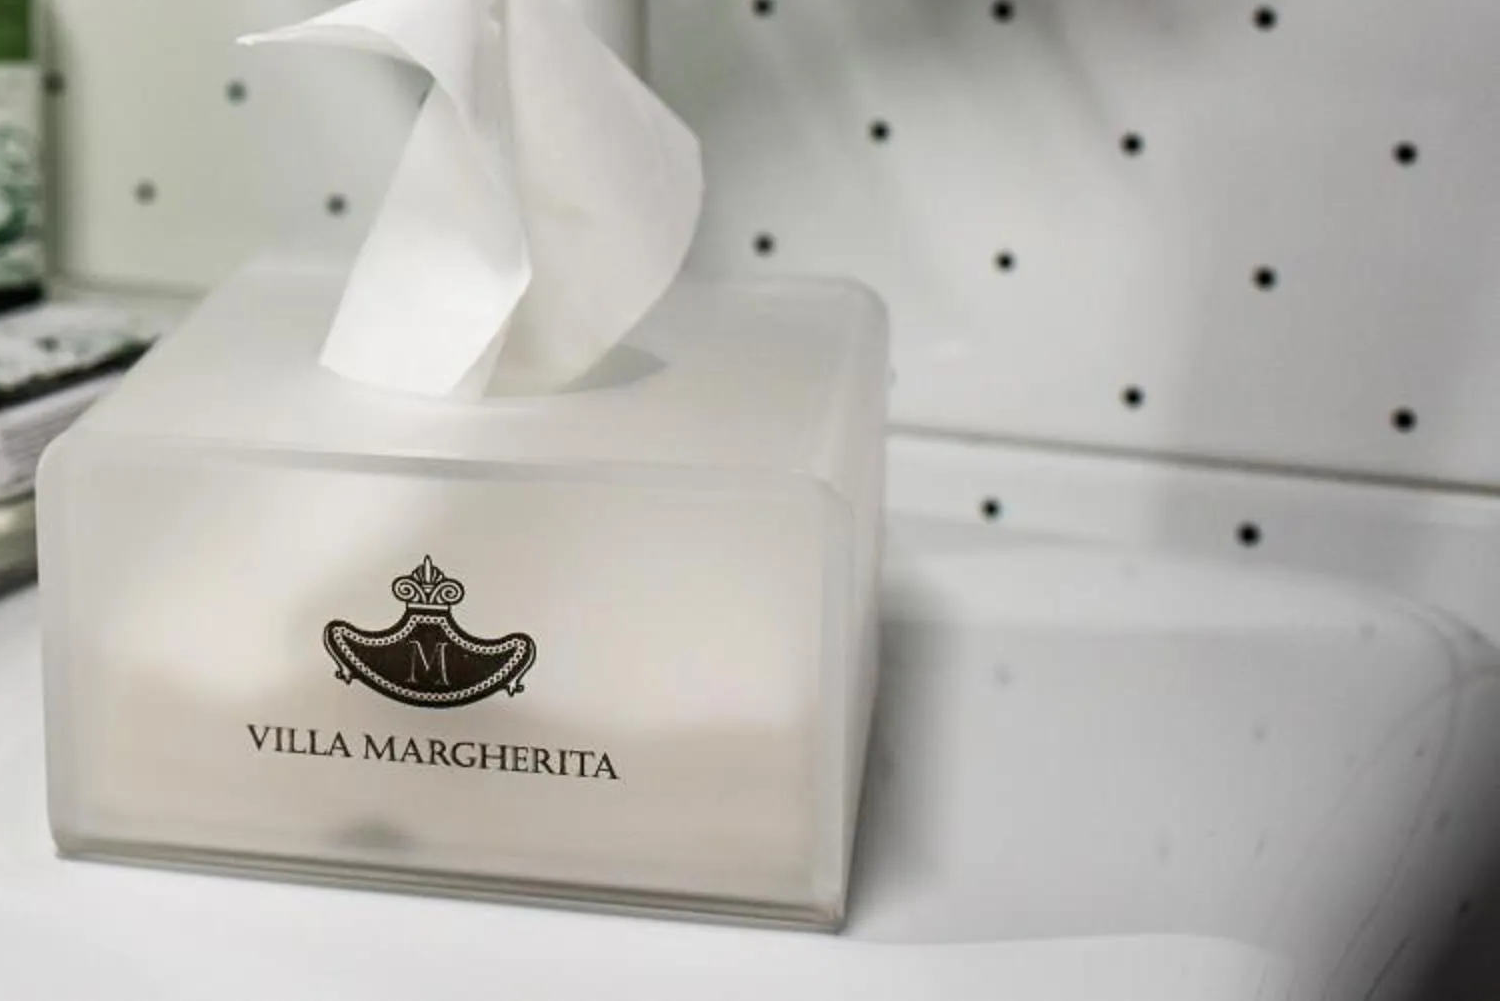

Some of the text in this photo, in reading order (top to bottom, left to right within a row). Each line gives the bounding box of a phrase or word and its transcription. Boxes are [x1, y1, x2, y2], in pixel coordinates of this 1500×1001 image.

[407, 640, 449, 686] M
[247, 724, 619, 779] VILLA MARGHERITA
